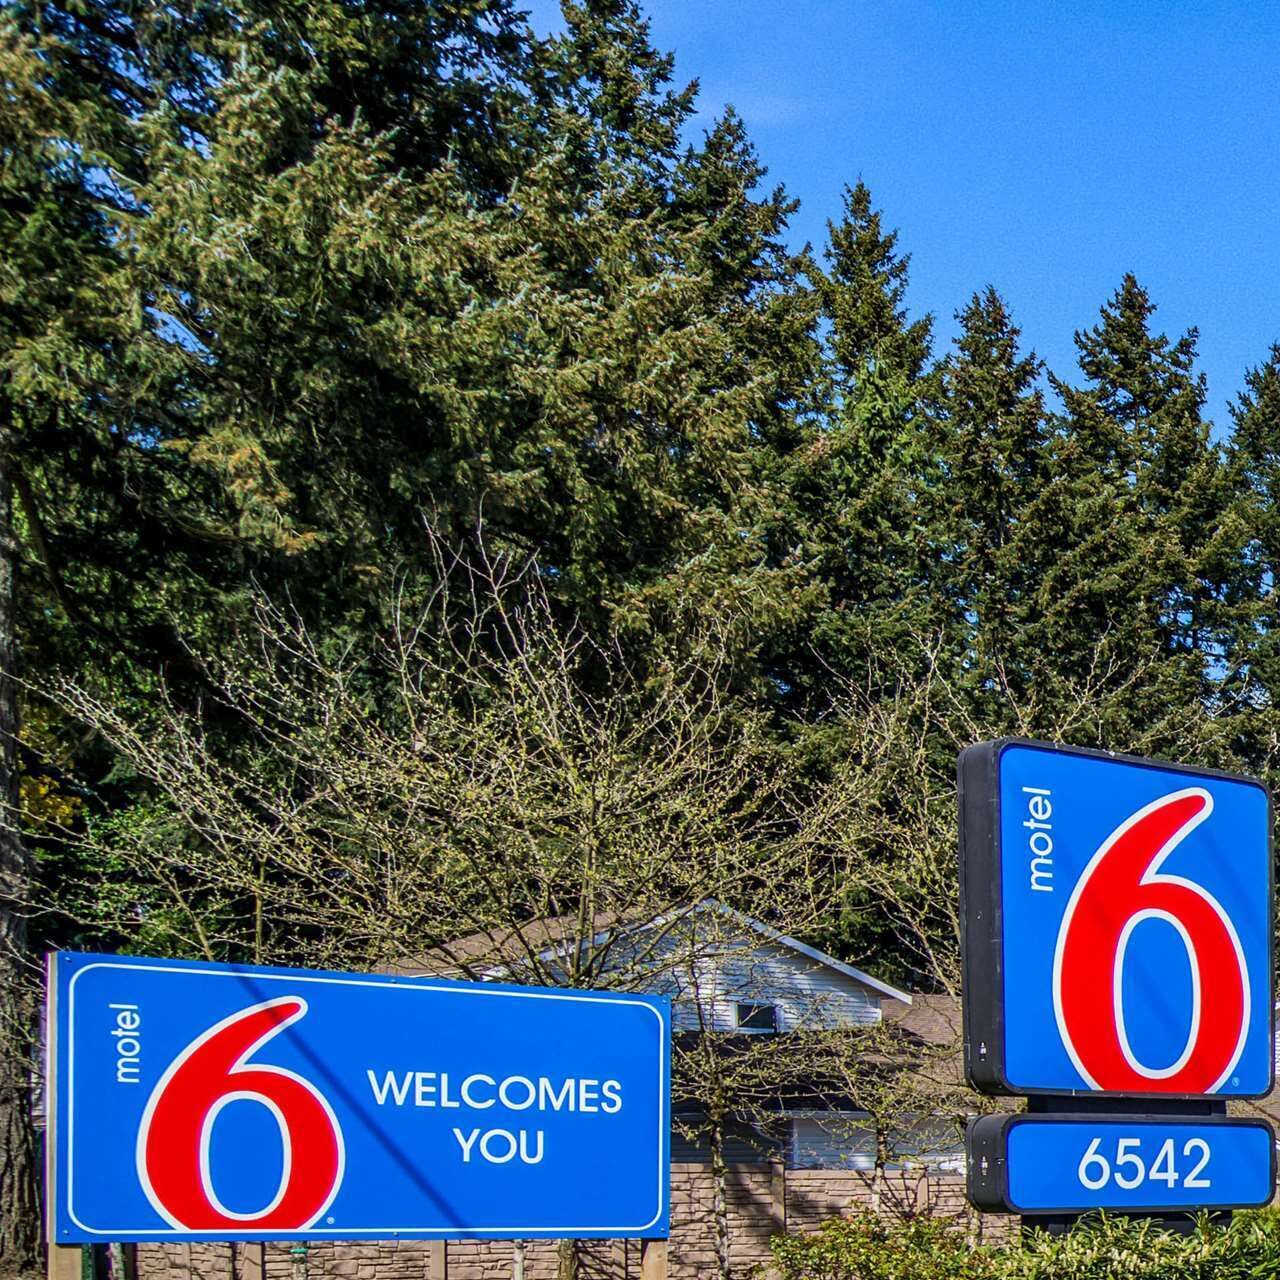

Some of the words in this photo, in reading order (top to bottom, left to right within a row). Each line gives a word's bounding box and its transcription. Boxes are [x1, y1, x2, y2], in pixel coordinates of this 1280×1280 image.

[1022, 786, 1054, 892] motel
[1052, 786, 1252, 1093] 6
[109, 1003, 141, 1083] motel
[135, 995, 346, 1230] 6
[367, 1069, 623, 1114] WELCOMES
[452, 1127, 544, 1164] YOU
[1078, 1137, 1211, 1190] 6542
